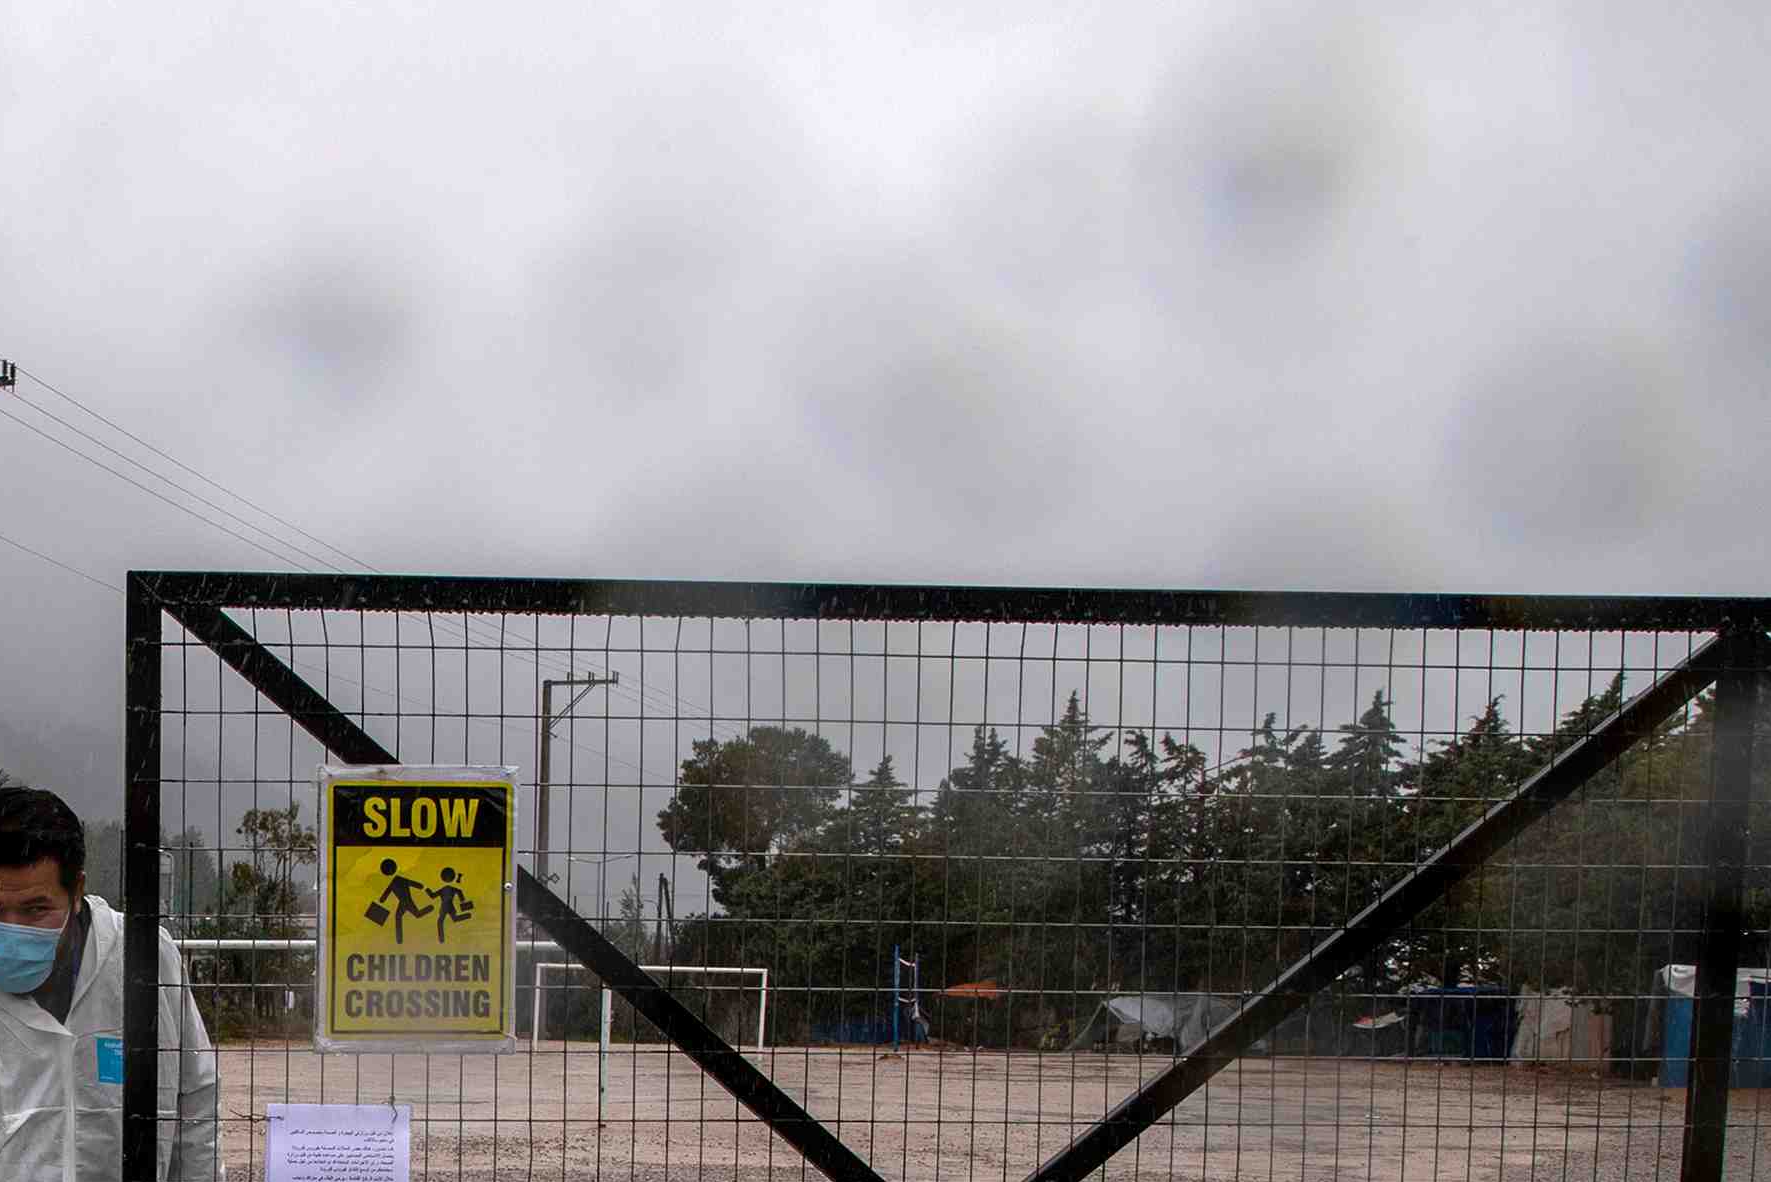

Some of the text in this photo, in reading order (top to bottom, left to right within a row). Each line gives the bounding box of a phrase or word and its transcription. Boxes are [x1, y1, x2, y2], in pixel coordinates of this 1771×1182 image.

[363, 796, 479, 839] SLOW
[346, 953, 490, 983] CHILDREN
[345, 989, 490, 1019] CROSSING
